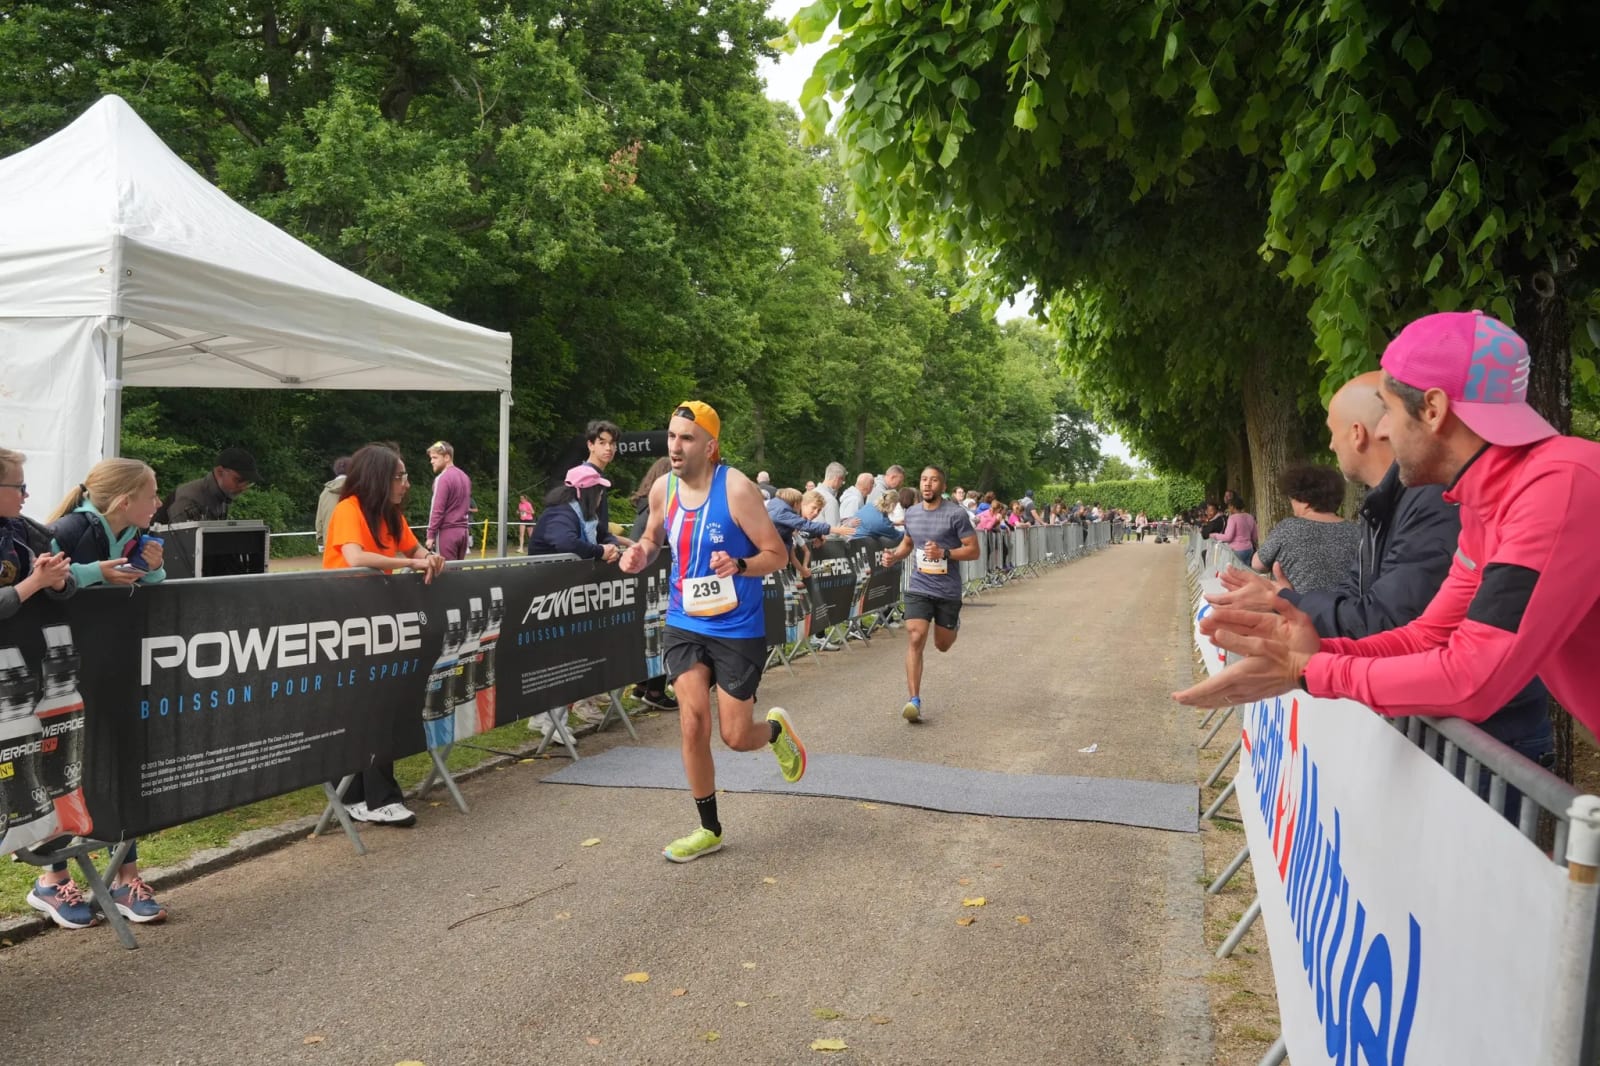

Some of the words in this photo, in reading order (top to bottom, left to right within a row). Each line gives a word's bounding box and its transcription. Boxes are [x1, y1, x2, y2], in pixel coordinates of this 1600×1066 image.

[614, 438, 651, 455] part
[692, 581, 721, 598] 239
[521, 578, 638, 624] POWERADE
[518, 626, 565, 646] BOISSON
[140, 685, 253, 720] BOISSON
[271, 674, 322, 698] POUR
[337, 668, 357, 688] LE
[369, 657, 420, 681] SPORT
